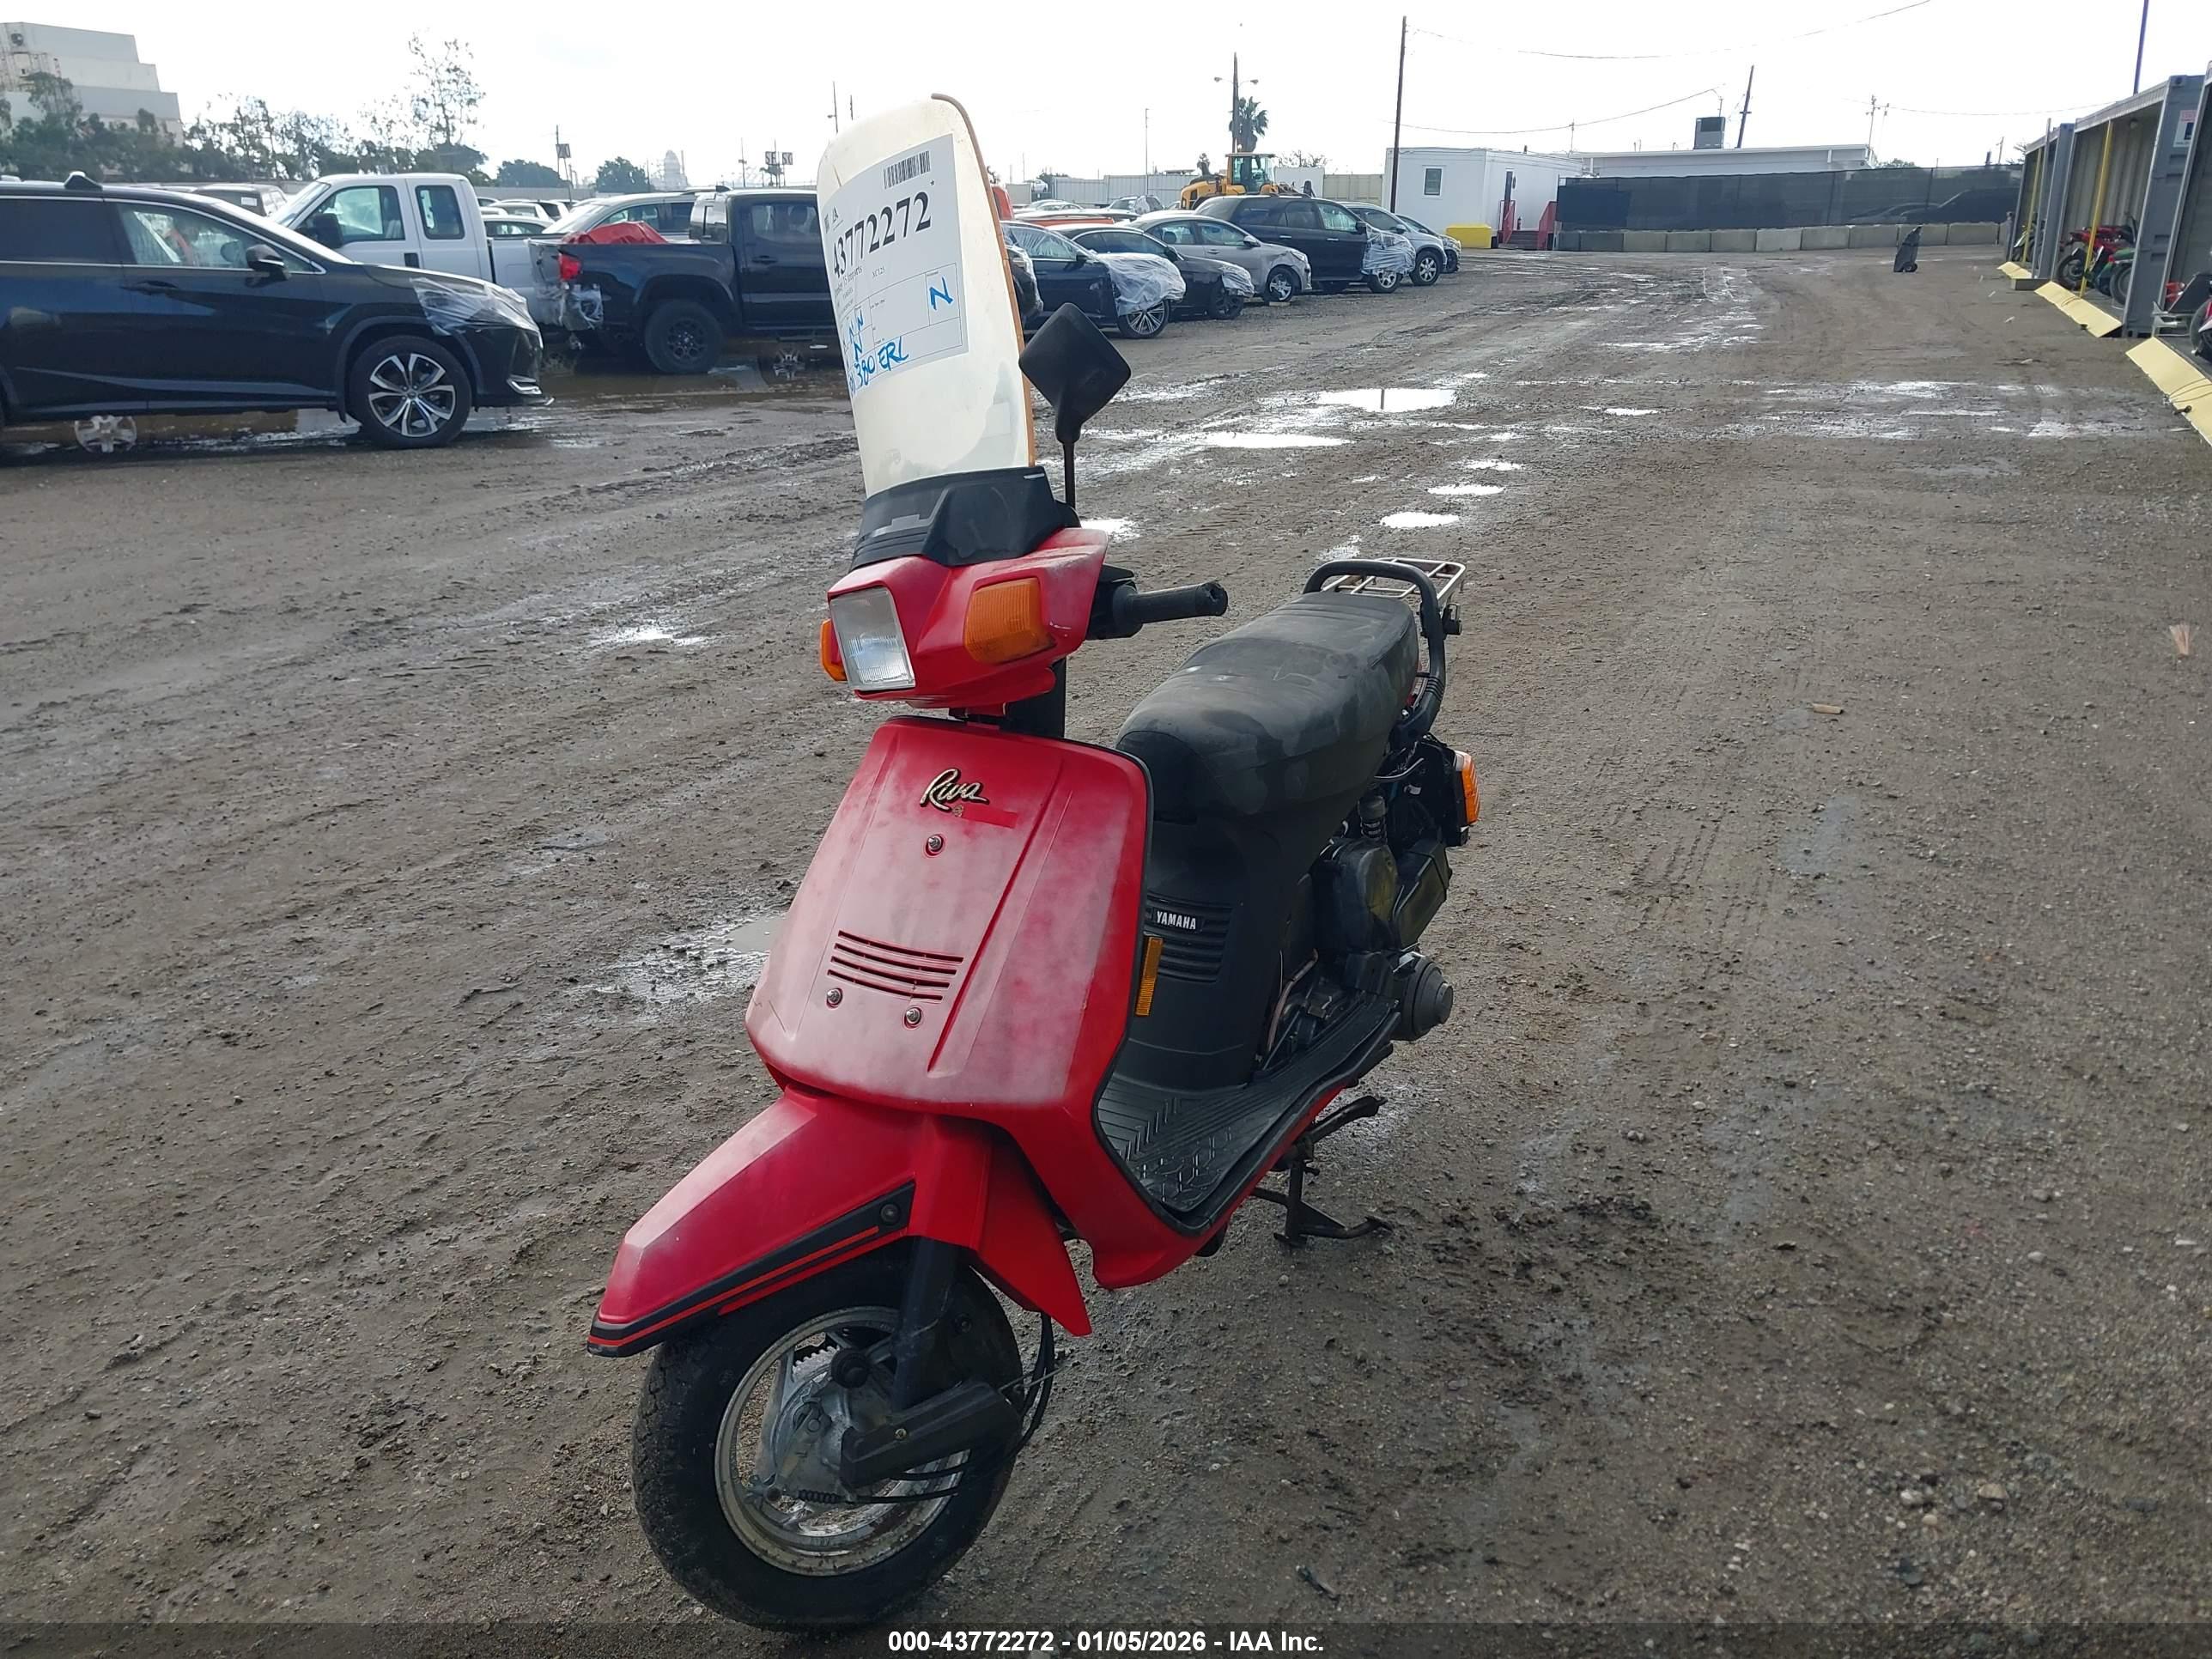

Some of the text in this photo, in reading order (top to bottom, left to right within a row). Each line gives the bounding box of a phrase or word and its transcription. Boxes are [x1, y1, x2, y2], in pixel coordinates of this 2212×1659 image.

[834, 191, 931, 278] 43772272
[929, 276, 953, 311] N
[919, 768, 989, 812] Riva
[1156, 910, 1196, 930] YAMAHA
